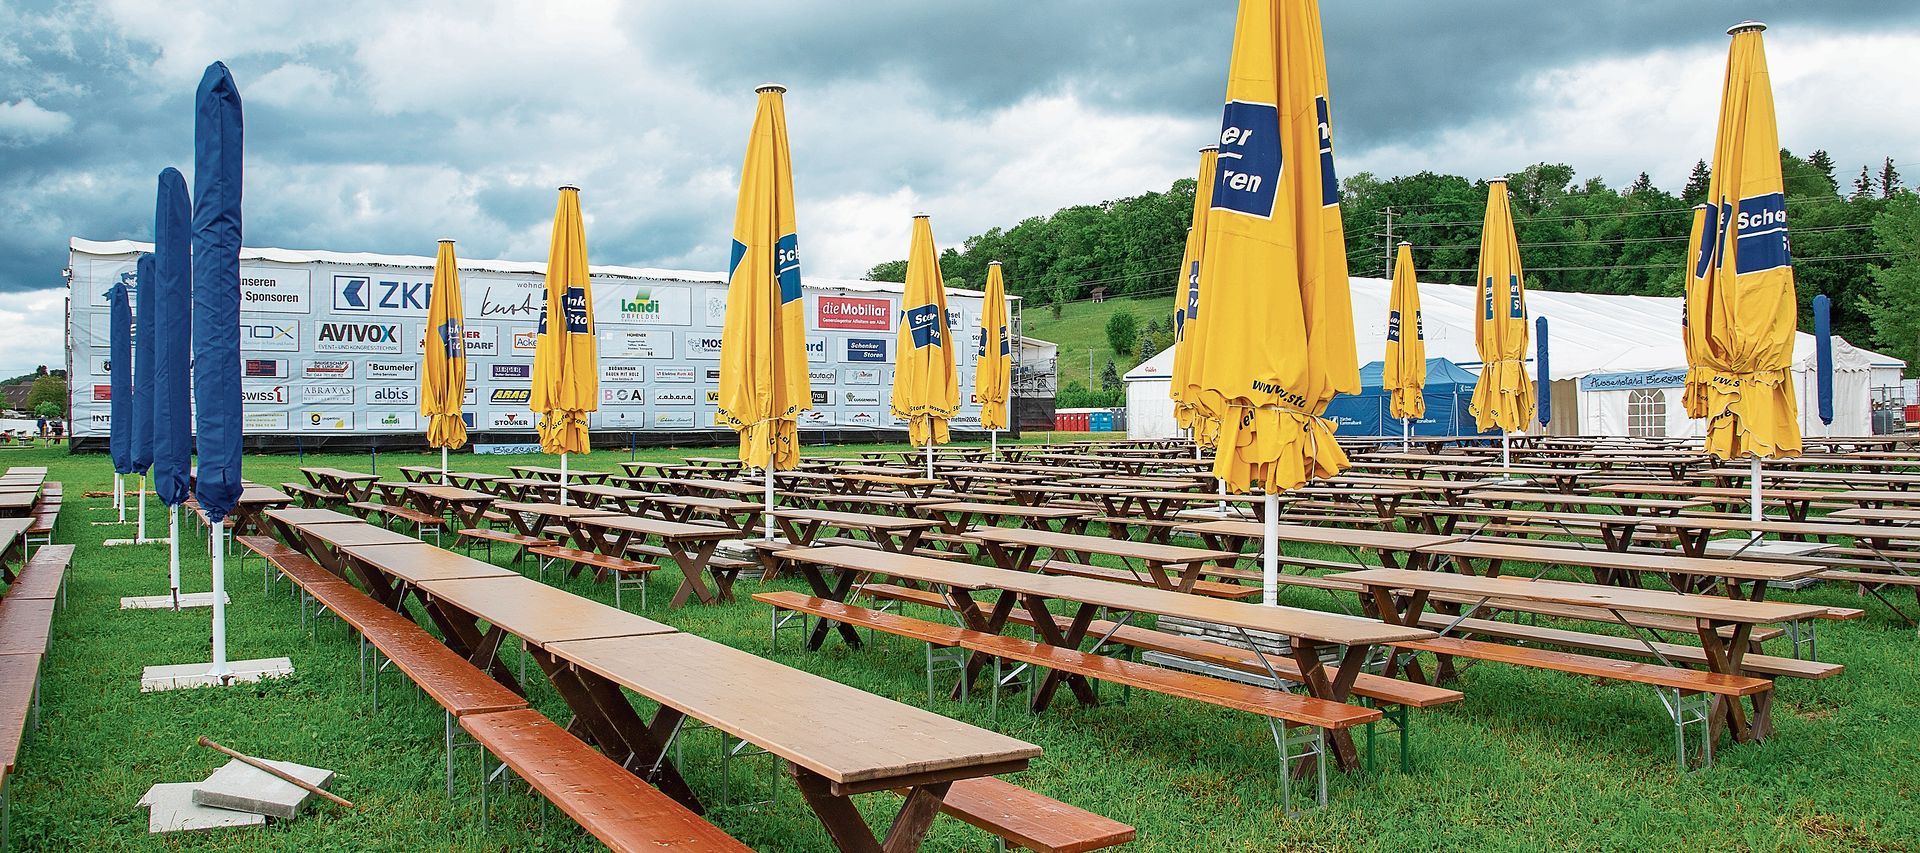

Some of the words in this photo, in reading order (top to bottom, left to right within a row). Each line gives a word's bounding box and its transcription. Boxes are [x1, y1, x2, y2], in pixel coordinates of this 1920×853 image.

[239, 277, 276, 287] nseren
[245, 290, 299, 303] Sponsoren
[621, 299, 660, 314] Landi
[822, 302, 840, 315] die
[841, 302, 887, 317] Mobiliar
[318, 323, 398, 343] AVIVOX
[463, 330, 481, 339] ER
[373, 363, 414, 372] Baumeler
[374, 387, 409, 400] albis
[493, 390, 530, 400] ARAG
